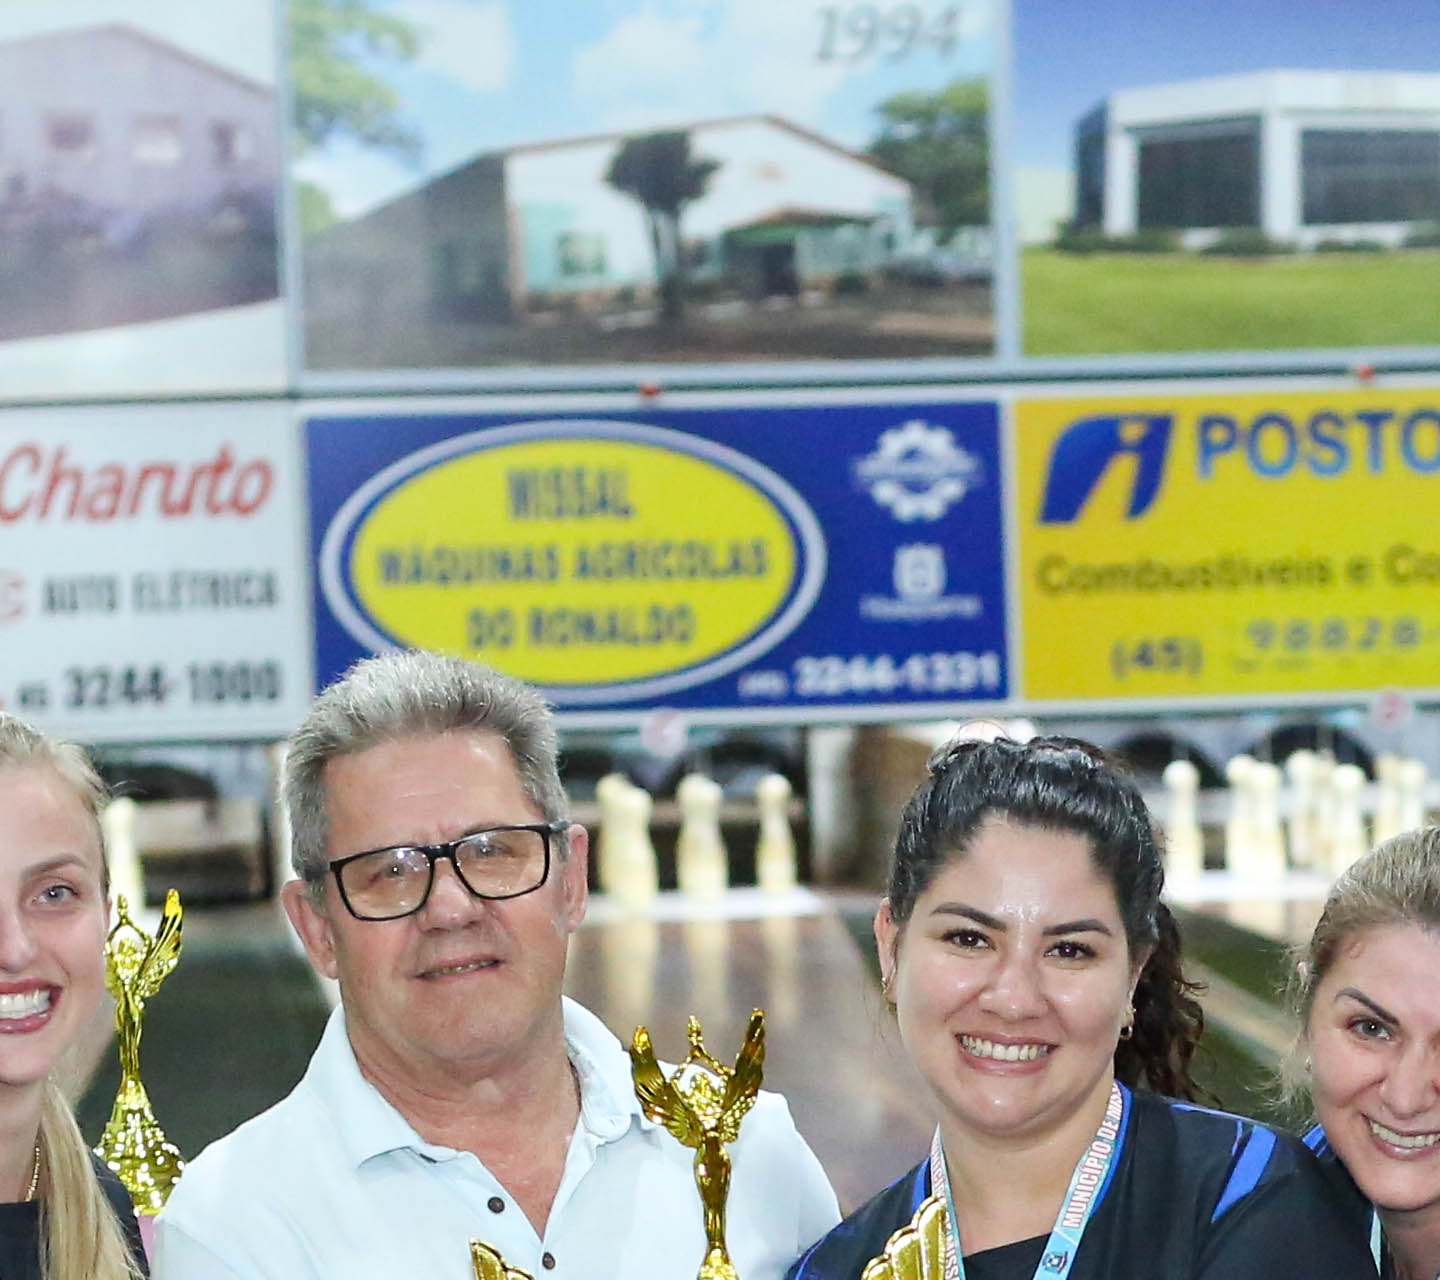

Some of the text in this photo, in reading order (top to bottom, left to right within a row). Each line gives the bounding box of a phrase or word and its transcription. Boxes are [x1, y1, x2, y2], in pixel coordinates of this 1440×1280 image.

[814, 3, 961, 66] 1994
[379, 535, 769, 586] MÁQUINAS AGRÍCOLAS
[1037, 553, 1331, 597] Combustíveis
[1347, 556, 1373, 587] e
[43, 566, 279, 614] AUTO ELÉTRICA
[468, 602, 697, 650] DO RONALDO
